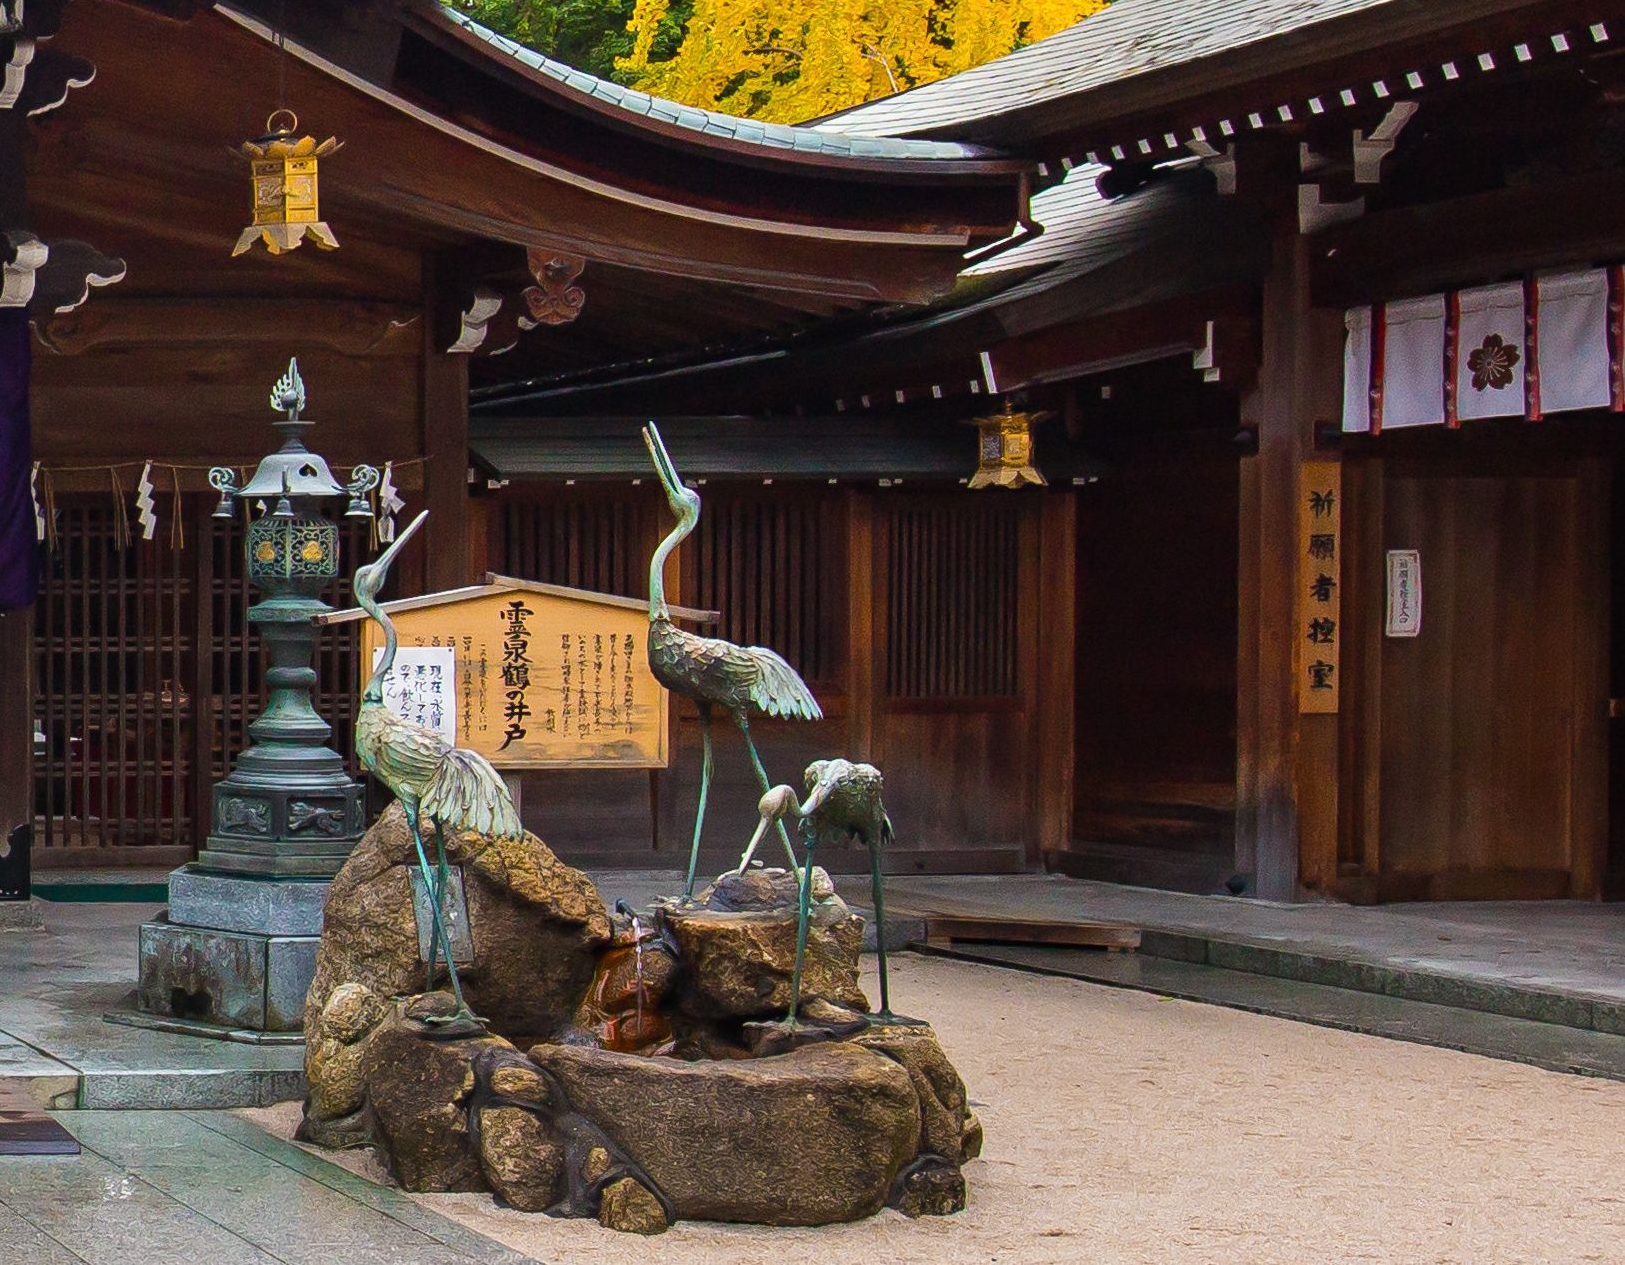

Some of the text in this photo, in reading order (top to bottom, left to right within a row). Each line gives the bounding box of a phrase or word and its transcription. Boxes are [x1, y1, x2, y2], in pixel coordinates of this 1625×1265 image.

[496, 600, 535, 753] 霊泉鶴の井戸
[1307, 489, 1336, 690] 祈願者控室
